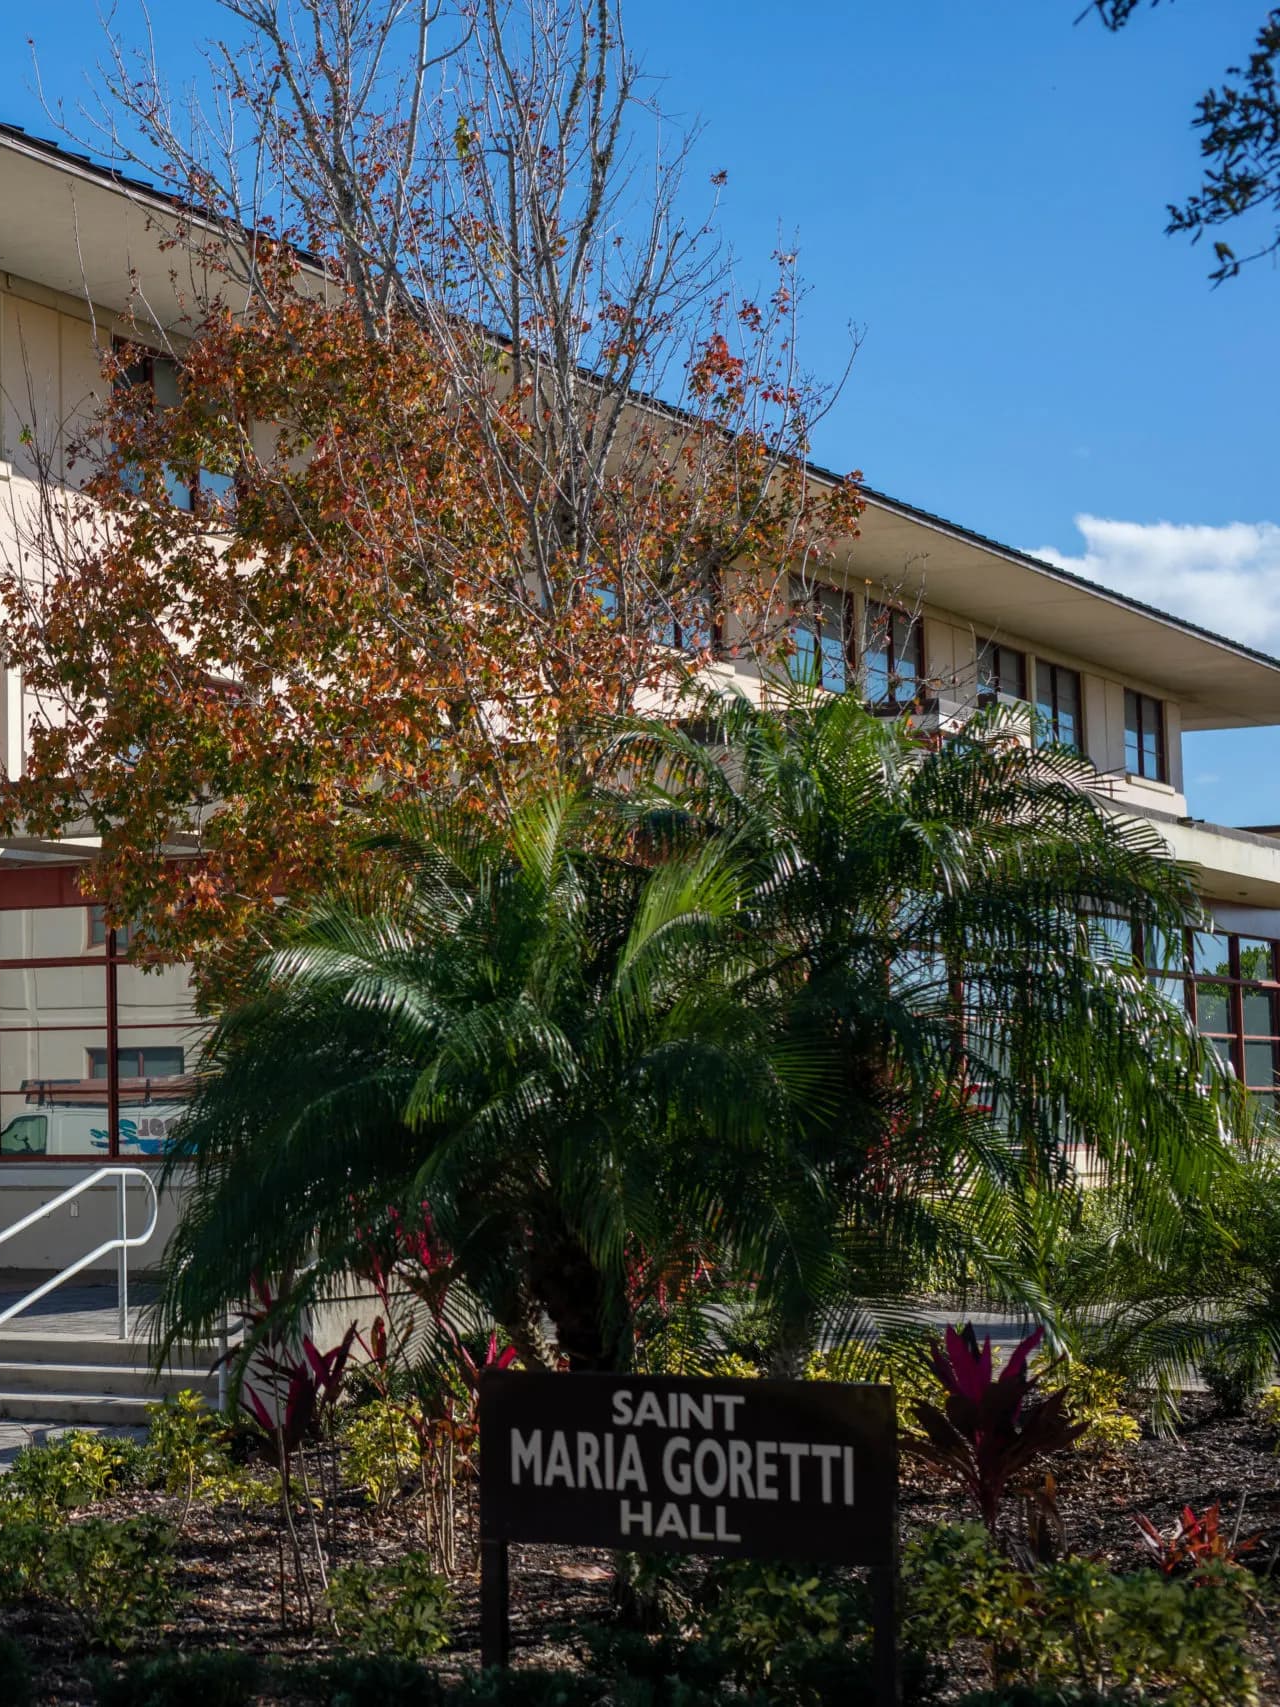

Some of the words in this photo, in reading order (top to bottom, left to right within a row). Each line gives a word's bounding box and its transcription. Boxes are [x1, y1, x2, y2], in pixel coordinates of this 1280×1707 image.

[612, 1390, 745, 1431] SAINT
[511, 1428, 648, 1492] MARIA
[663, 1437, 855, 1505] GORETTI
[621, 1500, 741, 1543] HALL
